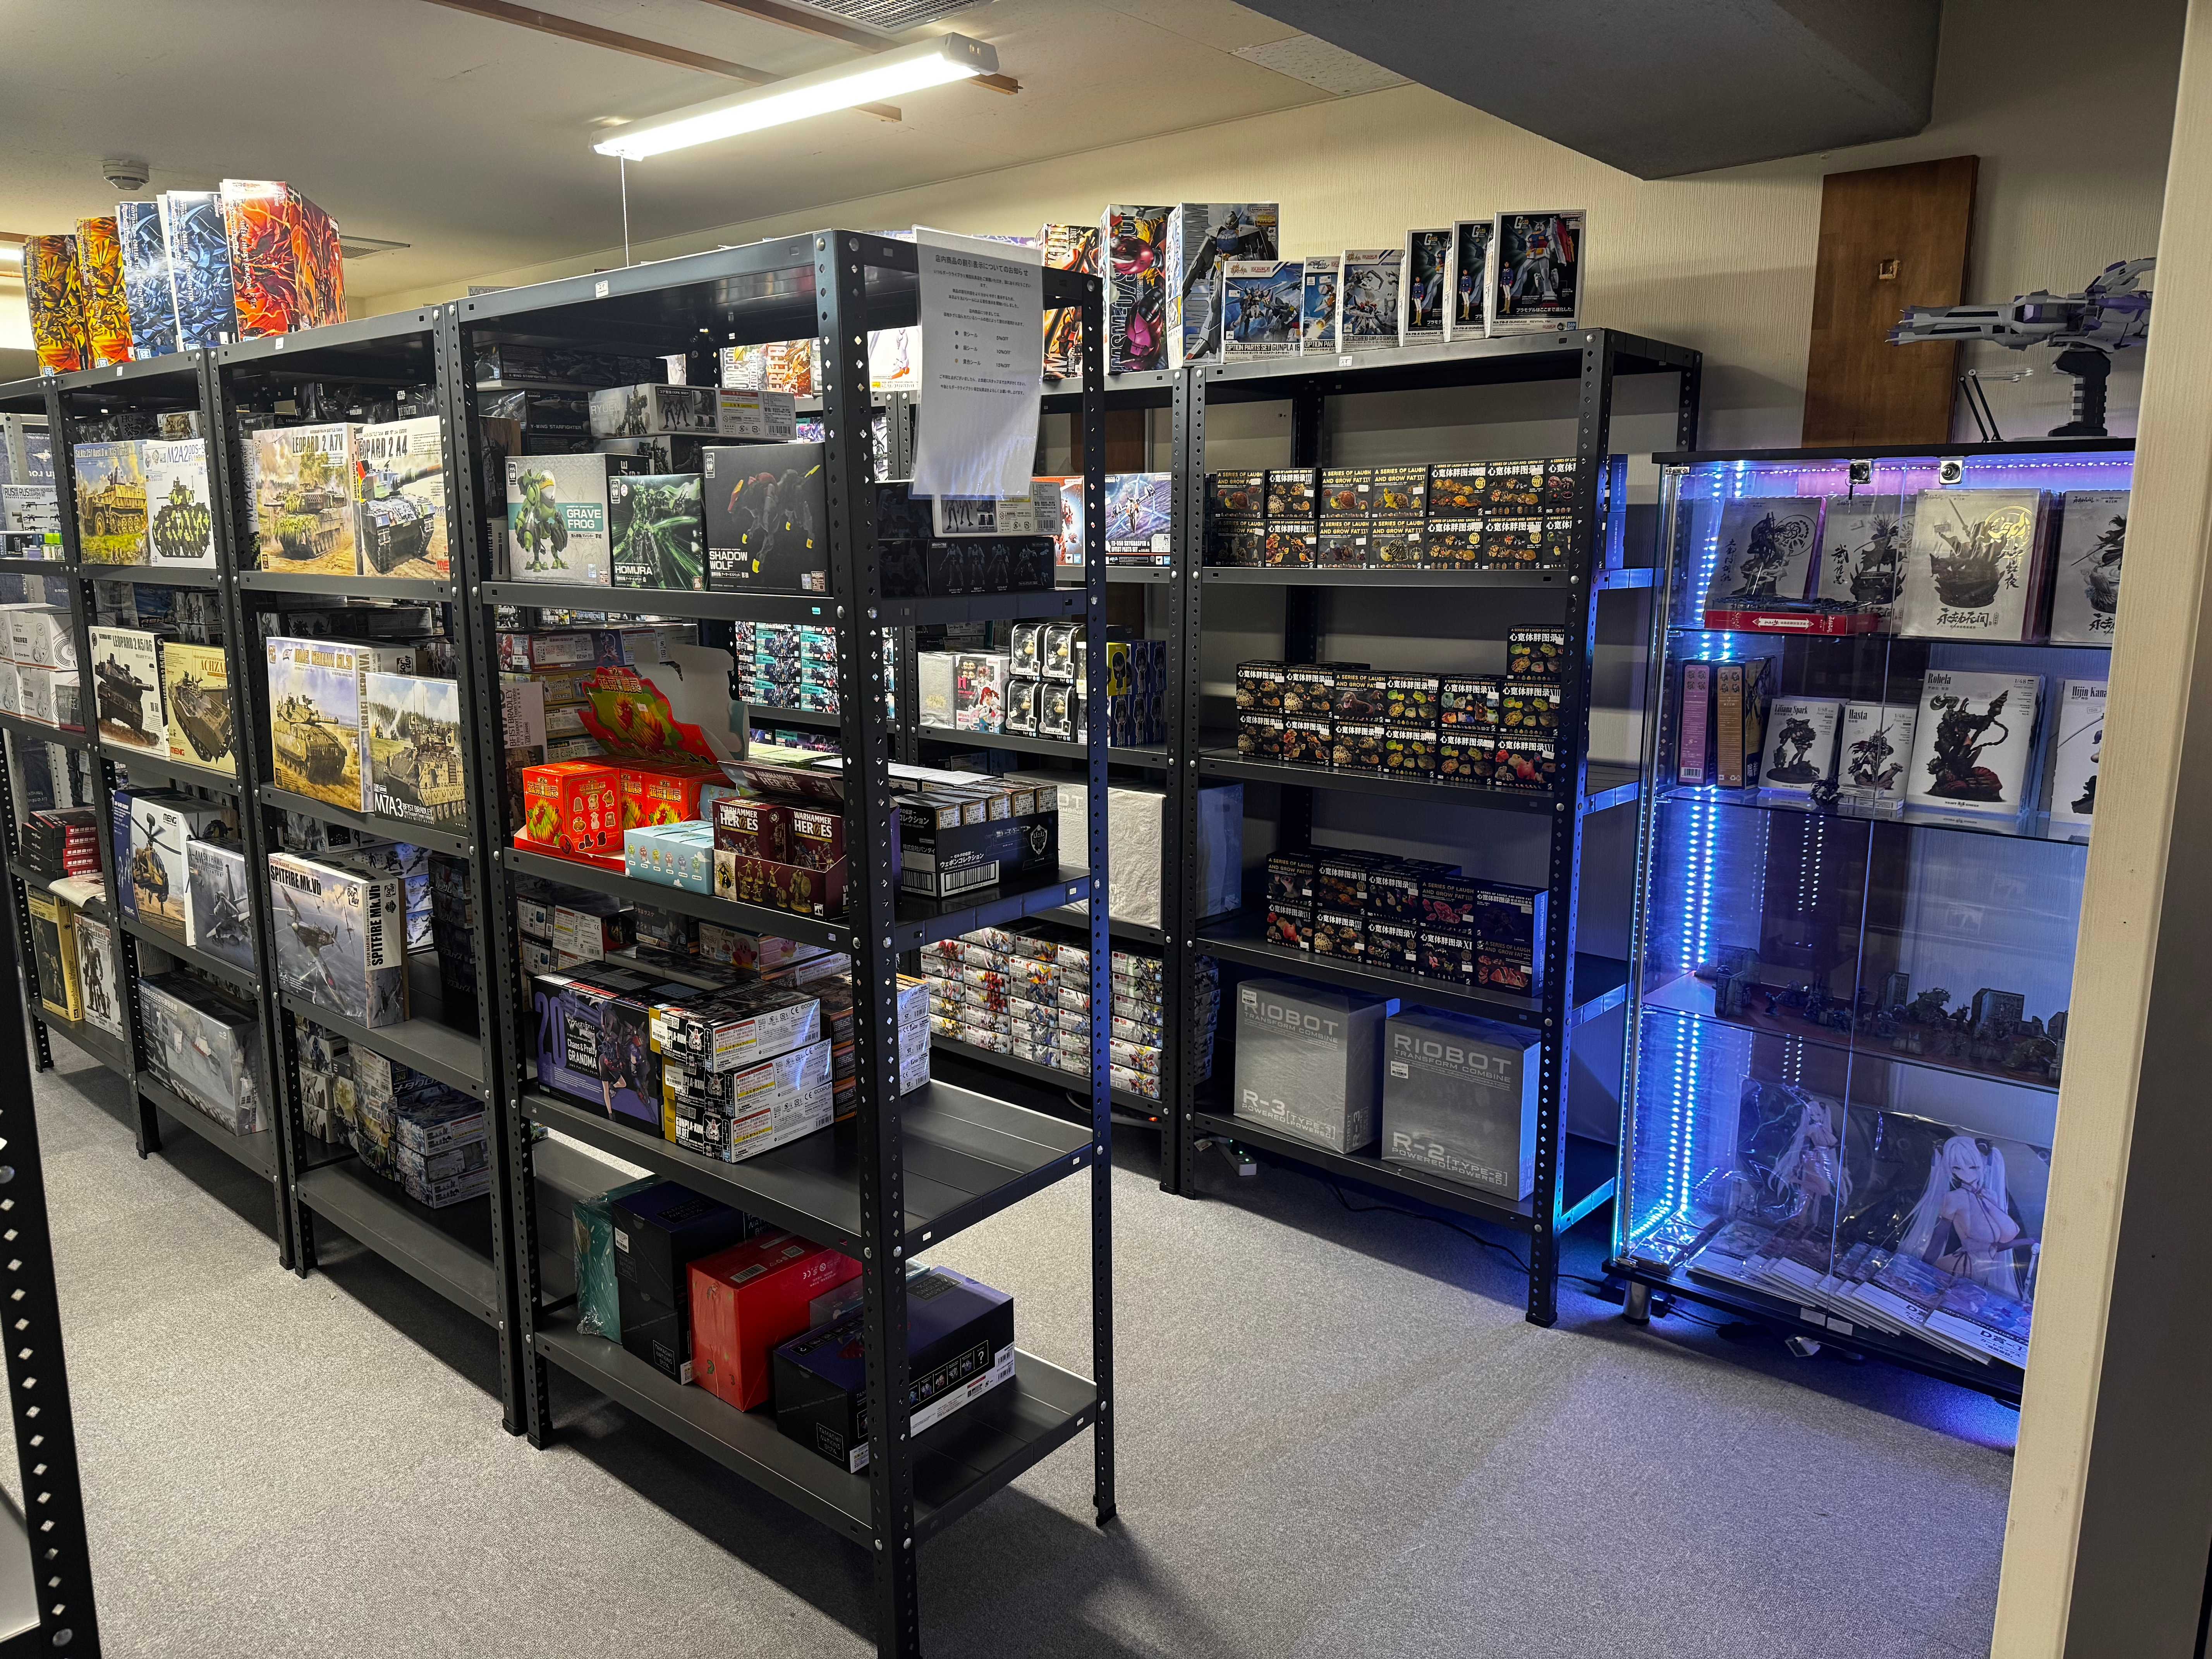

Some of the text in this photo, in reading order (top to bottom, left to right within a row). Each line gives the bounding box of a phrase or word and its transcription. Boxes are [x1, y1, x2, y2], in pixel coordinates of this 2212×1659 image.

[936, 255, 1029, 276] 店内商品の割引表示についてのお知らせ
[185, 266, 194, 302] TORMENTOR
[244, 263, 252, 290] DRAGON
[292, 434, 343, 453] LEOPARD 2 A7V
[357, 438, 386, 460] LEOPARD
[388, 436, 393, 458] 2
[396, 435, 407, 457] A4
[167, 444, 205, 463] M2A2 ODS-S
[5, 488, 15, 496] RUS
[19, 488, 29, 496] RUS
[566, 509, 601, 519] GRAVE
[568, 519, 595, 529] FROG
[709, 551, 747, 561] SHADOW
[615, 565, 653, 575] HOMURA
[709, 561, 733, 570] WOLF
[1937, 608, 1990, 628] 永劫无间
[112, 635, 133, 649] LEOPARD
[134, 638, 137, 649] 2
[138, 639, 153, 652] A5/A6
[295, 649, 309, 664] ISRAEL
[1928, 673, 1951, 685] Rohela
[2072, 685, 2088, 698] Hijin
[506, 689, 515, 723] BRADLEY
[1775, 704, 1793, 713] Liliana
[1793, 706, 1808, 715] Spark
[1849, 709, 1868, 720] Hasta
[170, 747, 185, 756] MENG
[756, 771, 793, 783] WARHAMMER
[761, 777, 801, 791] HEROES
[375, 793, 404, 817] M7A3
[403, 803, 433, 816] BFIST BRADLEY
[720, 805, 757, 819] WARHAMMER
[163, 813, 177, 824] MENG
[720, 816, 758, 831] HEROES
[794, 811, 832, 825] WARHAMMER
[794, 819, 832, 838] HEROES
[903, 844, 936, 854] 株式会社バンダイ
[203, 853, 223, 866] SKYHAWK
[270, 858, 290, 869] SUPER MARINE
[940, 853, 984, 868] ウェポンコレクション
[271, 865, 321, 896] SPITFIRE Mk.Vb
[369, 884, 383, 966] SPITFIRE Mk.Vb
[1244, 1001, 1339, 1036] RIOBOT
[1244, 1012, 1338, 1044] TRANSFORM COMBINE
[568, 1038, 580, 1050] Chaos
[584, 1044, 597, 1058] Pretty
[1394, 1034, 1512, 1075] RIOBOT
[568, 1049, 597, 1070] GRANDMA
[1394, 1049, 1511, 1083] TRANSFORM COMBINE
[1243, 1089, 1286, 1116] R-3
[1242, 1103, 1285, 1122] POWERED
[682, 1127, 690, 1137] SET
[1393, 1132, 1445, 1161] R-2
[1392, 1147, 1446, 1168] POWERED
[655, 1343, 673, 1358] TAMASHII
[656, 1351, 673, 1366] NATIONS
[819, 1426, 841, 1443] TAMASHII
[820, 1433, 840, 1450] NATIONS
